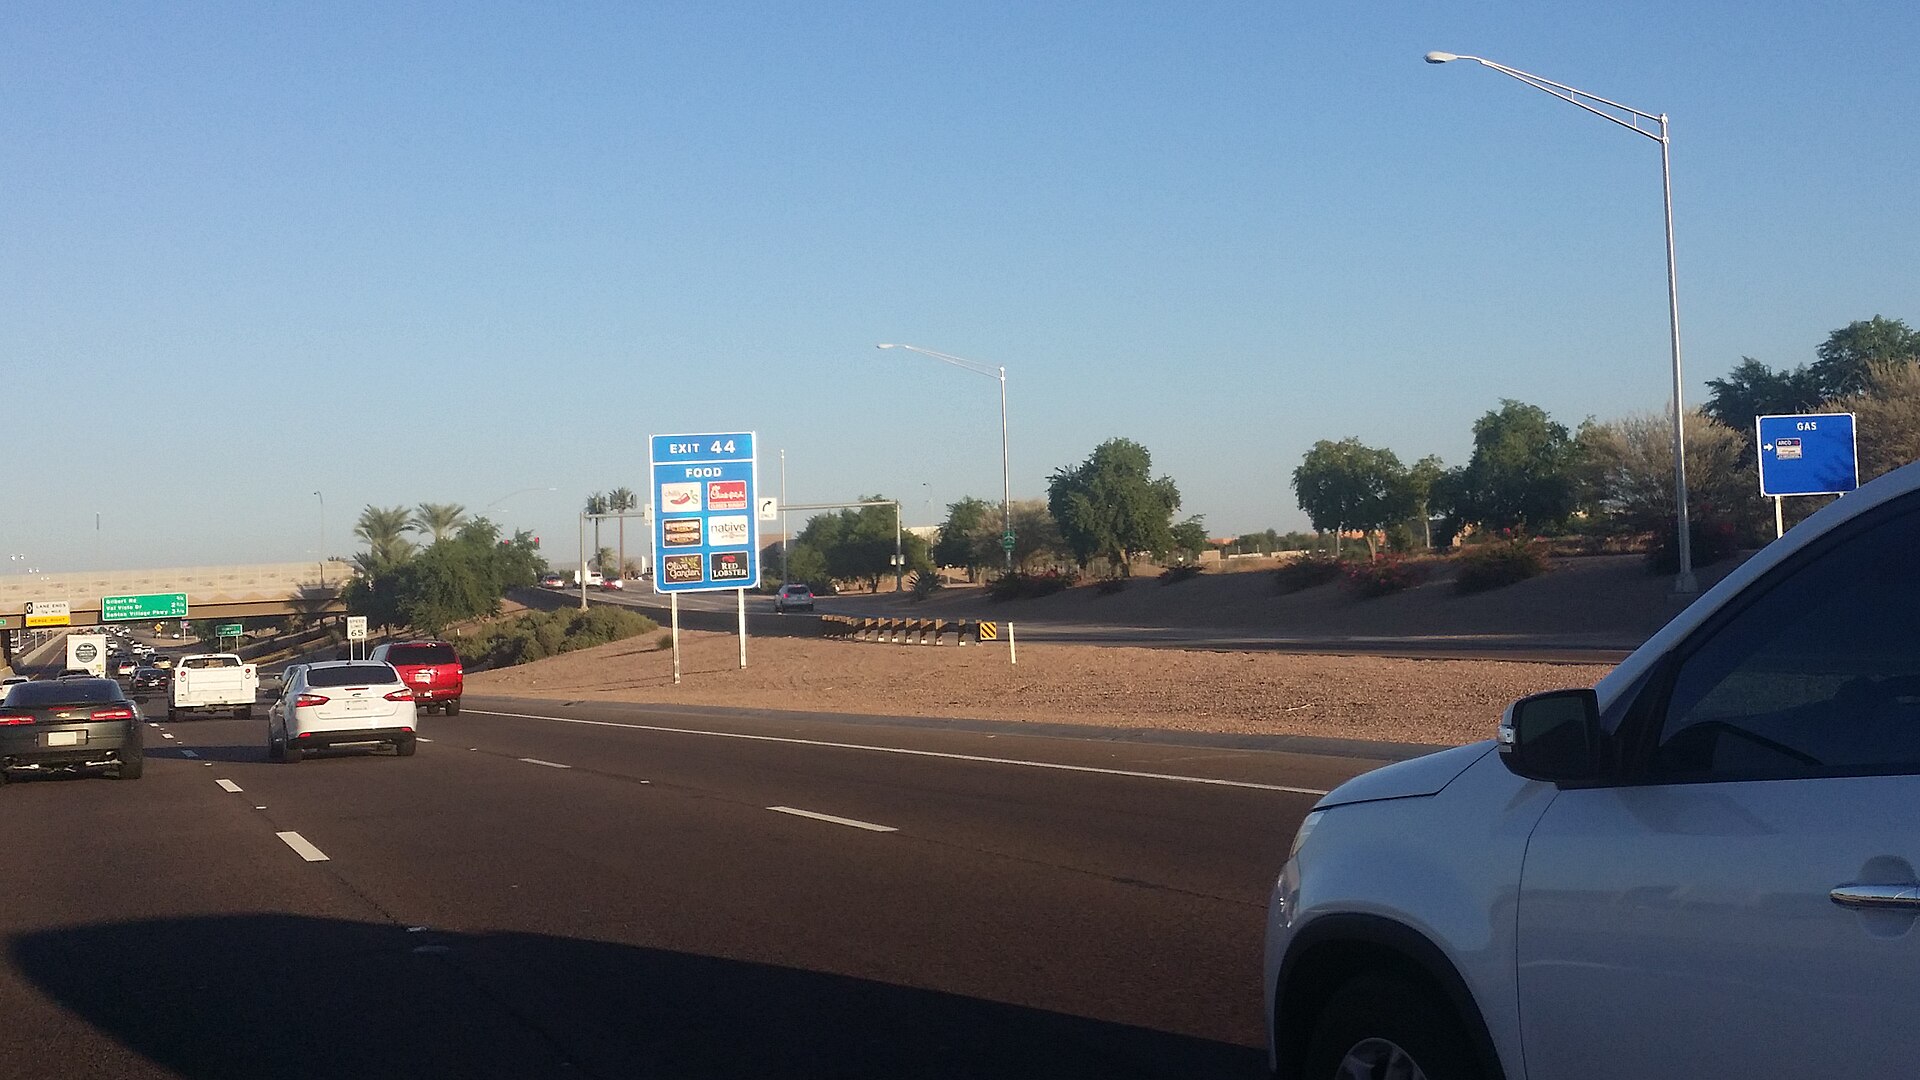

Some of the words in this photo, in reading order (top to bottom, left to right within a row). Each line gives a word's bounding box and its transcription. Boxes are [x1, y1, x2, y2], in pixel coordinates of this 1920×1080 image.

[1797, 422, 1817, 431] GAS
[669, 444, 700, 454] EXIT
[711, 440, 736, 454] 44
[686, 467, 722, 478] FOOD
[664, 489, 699, 505] ch's
[711, 521, 746, 533] native
[666, 561, 689, 571] Olive
[721, 562, 738, 570] RED
[713, 569, 747, 578] LOBSTER
